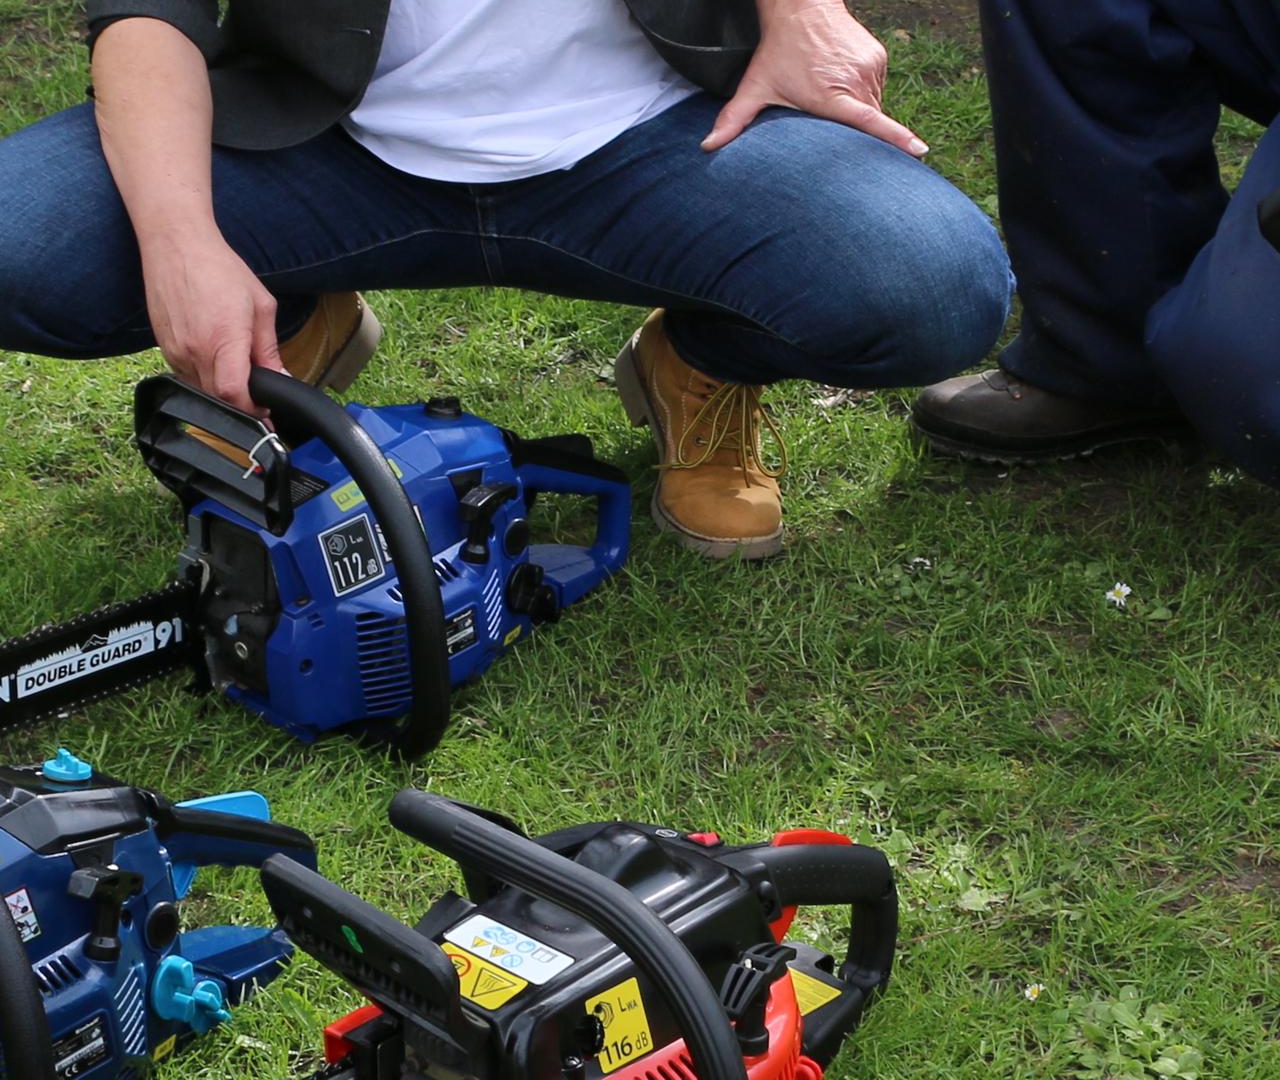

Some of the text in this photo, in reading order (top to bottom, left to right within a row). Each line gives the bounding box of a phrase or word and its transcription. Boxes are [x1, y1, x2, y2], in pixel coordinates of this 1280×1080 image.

[334, 552, 366, 587] 112
[24, 658, 86, 692] DOUBLE
[90, 638, 143, 668] GUARD
[155, 617, 183, 649] 91
[602, 1031, 649, 1065] 116 dB
